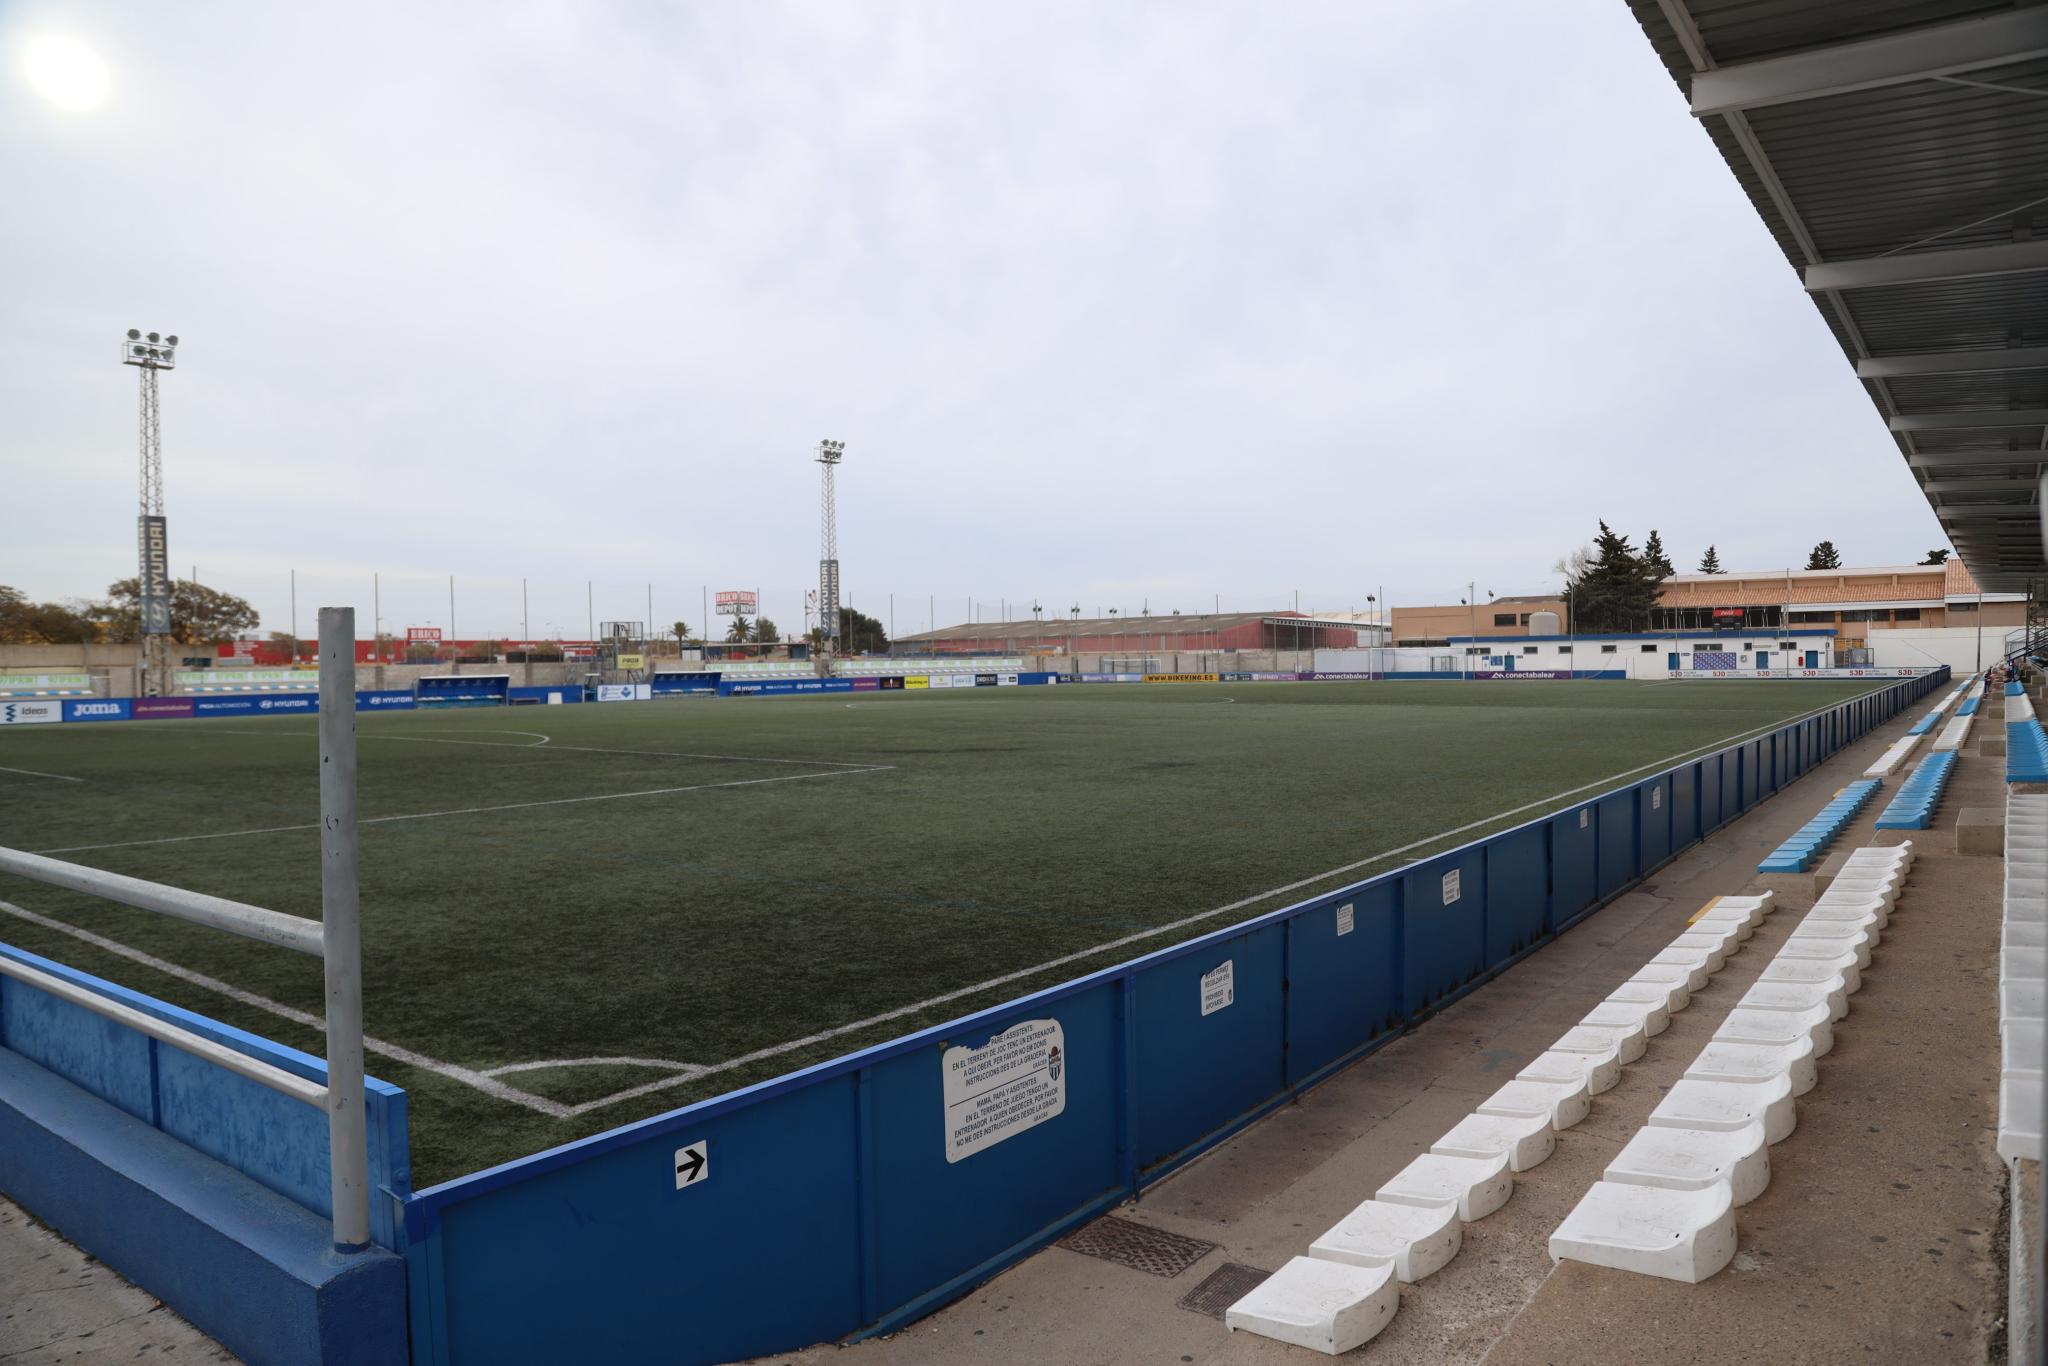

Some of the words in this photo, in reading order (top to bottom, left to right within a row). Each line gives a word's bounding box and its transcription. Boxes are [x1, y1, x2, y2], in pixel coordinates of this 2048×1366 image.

[149, 522, 165, 596] HYUNDAI
[1325, 672, 1369, 680] conectabalear
[1505, 671, 1555, 679] conectabalear
[1757, 670, 1770, 678] SJD
[274, 700, 309, 708] HYUNDAI
[382, 697, 413, 705] HYUNDAI
[952, 1061, 959, 1070] EN
[960, 1059, 966, 1068] EL
[989, 1048, 996, 1056] DE
[996, 1044, 1006, 1054] JOC
[1026, 1025, 1055, 1042] ENTRENADOR
[993, 1055, 1002, 1065] PER
[1003, 1049, 1018, 1061] FAVOR
[1018, 1047, 1025, 1055] NO
[966, 1067, 999, 1086] INSTRUCCIONS
[1000, 1063, 1009, 1072] DES
[1010, 1060, 1016, 1068] DE
[1017, 1057, 1023, 1066] LA
[965, 1113, 972, 1122] EN
[973, 1111, 979, 1119] EL
[980, 1101, 1002, 1116] TERRENO
[1003, 1098, 1009, 1106] DE
[1010, 1091, 1025, 1103] JUEGO
[1026, 1085, 1041, 1096] TENGO
[1042, 1082, 1048, 1090] UN
[993, 1109, 1007, 1121] QUIEN
[1034, 1093, 1043, 1103] POR
[1044, 1086, 1058, 1098] FAVOR
[956, 1138, 964, 1147] NO
[965, 1134, 972, 1143] ME
[973, 1129, 982, 1140] DES
[983, 1113, 1020, 1135] INSTRUCCIONES
[1020, 1106, 1035, 1118] DESDE
[1036, 1104, 1041, 1112] LA
[1042, 1097, 1057, 1109] GRADA
